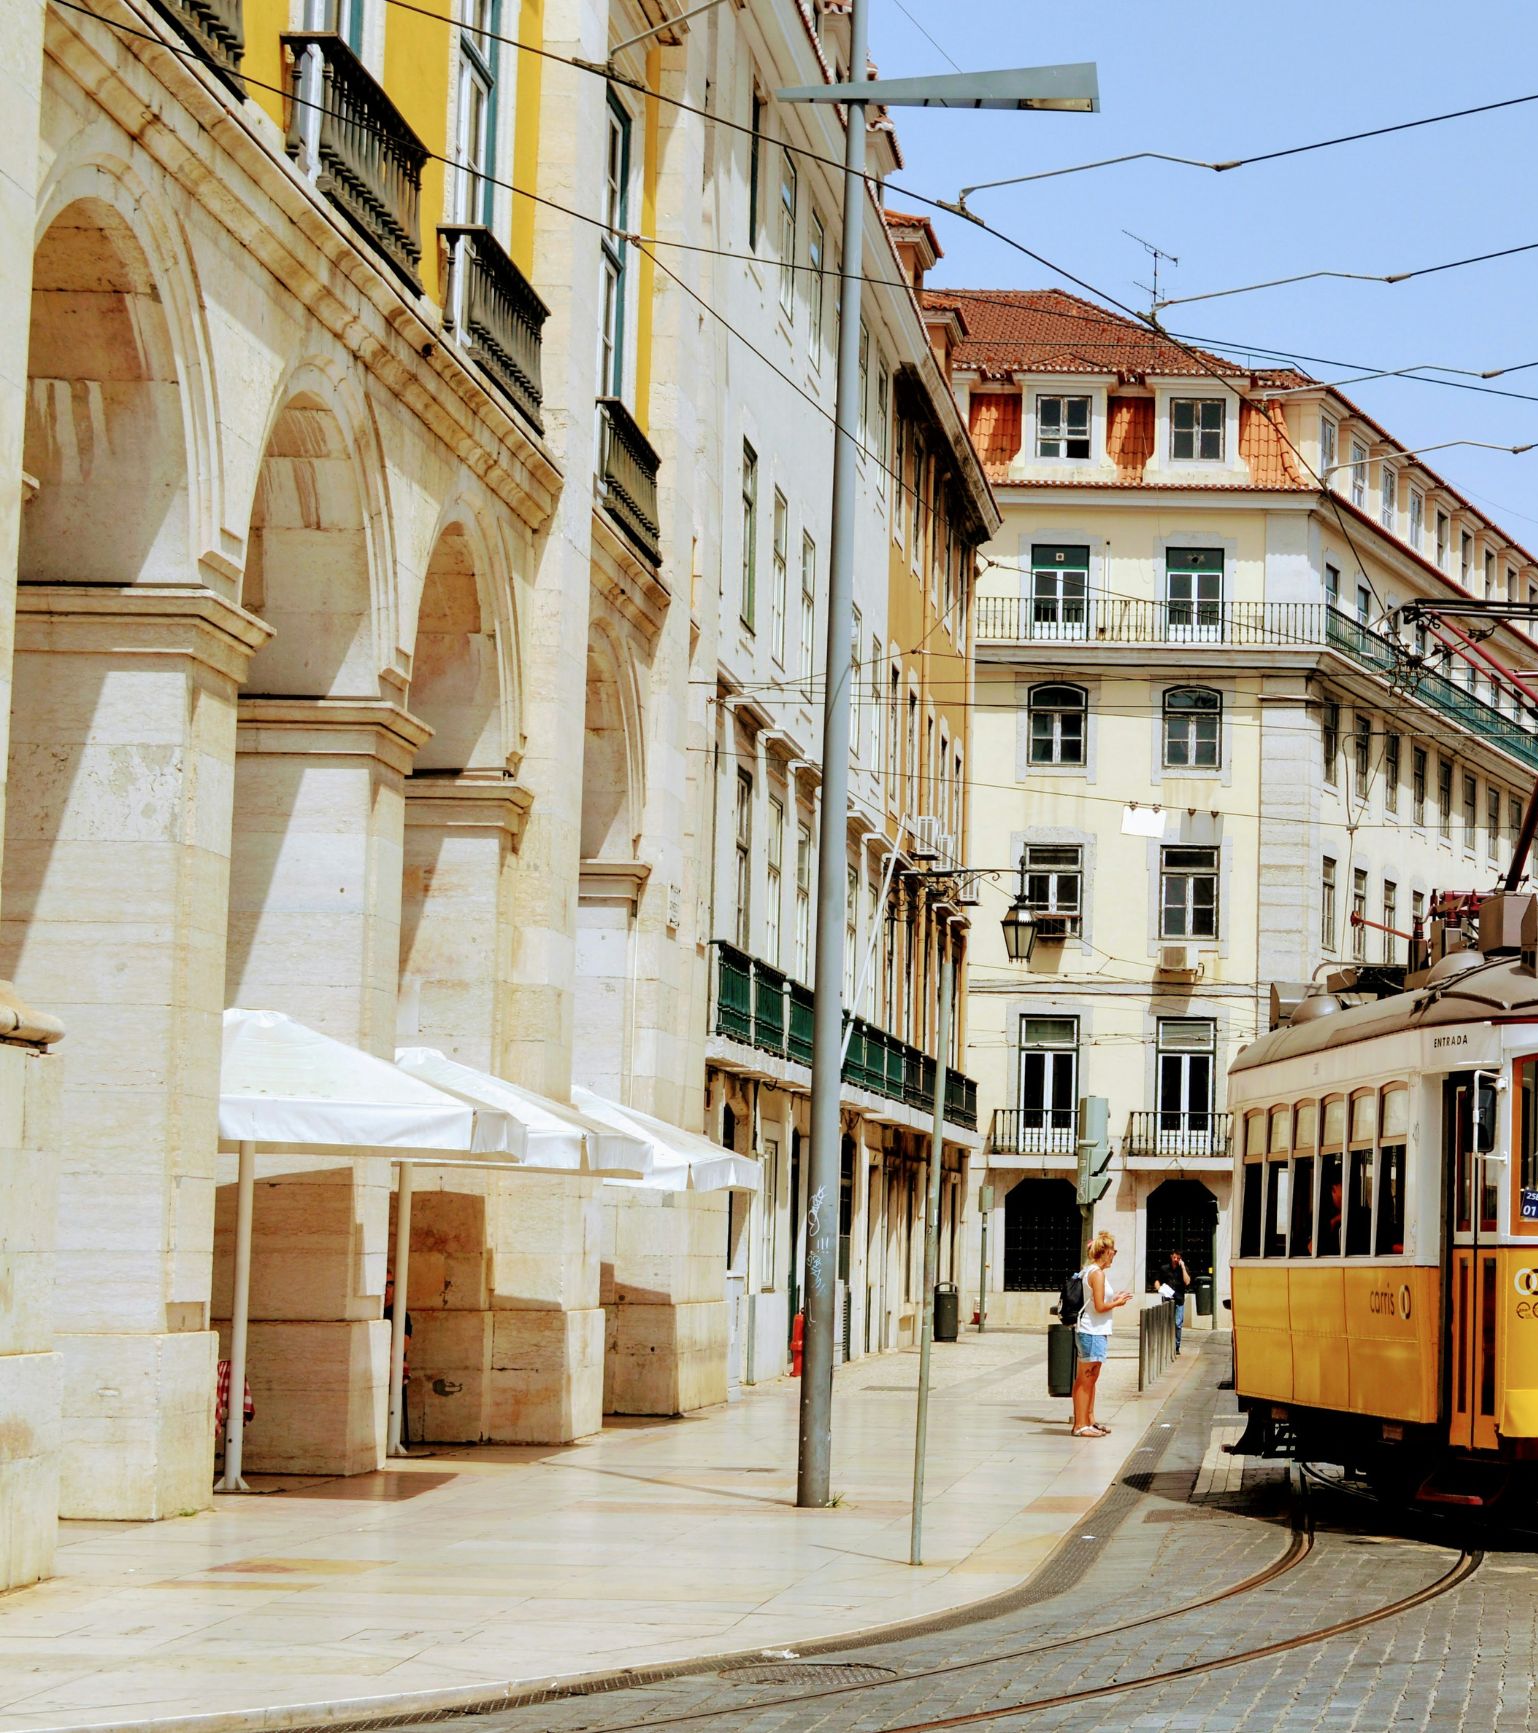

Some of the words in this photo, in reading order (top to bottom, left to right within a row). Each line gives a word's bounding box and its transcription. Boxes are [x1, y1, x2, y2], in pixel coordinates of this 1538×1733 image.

[1433, 1034, 1468, 1048] ENTRADA
[1523, 1205, 1537, 1216] 01
[1370, 1281, 1395, 1316] carris
